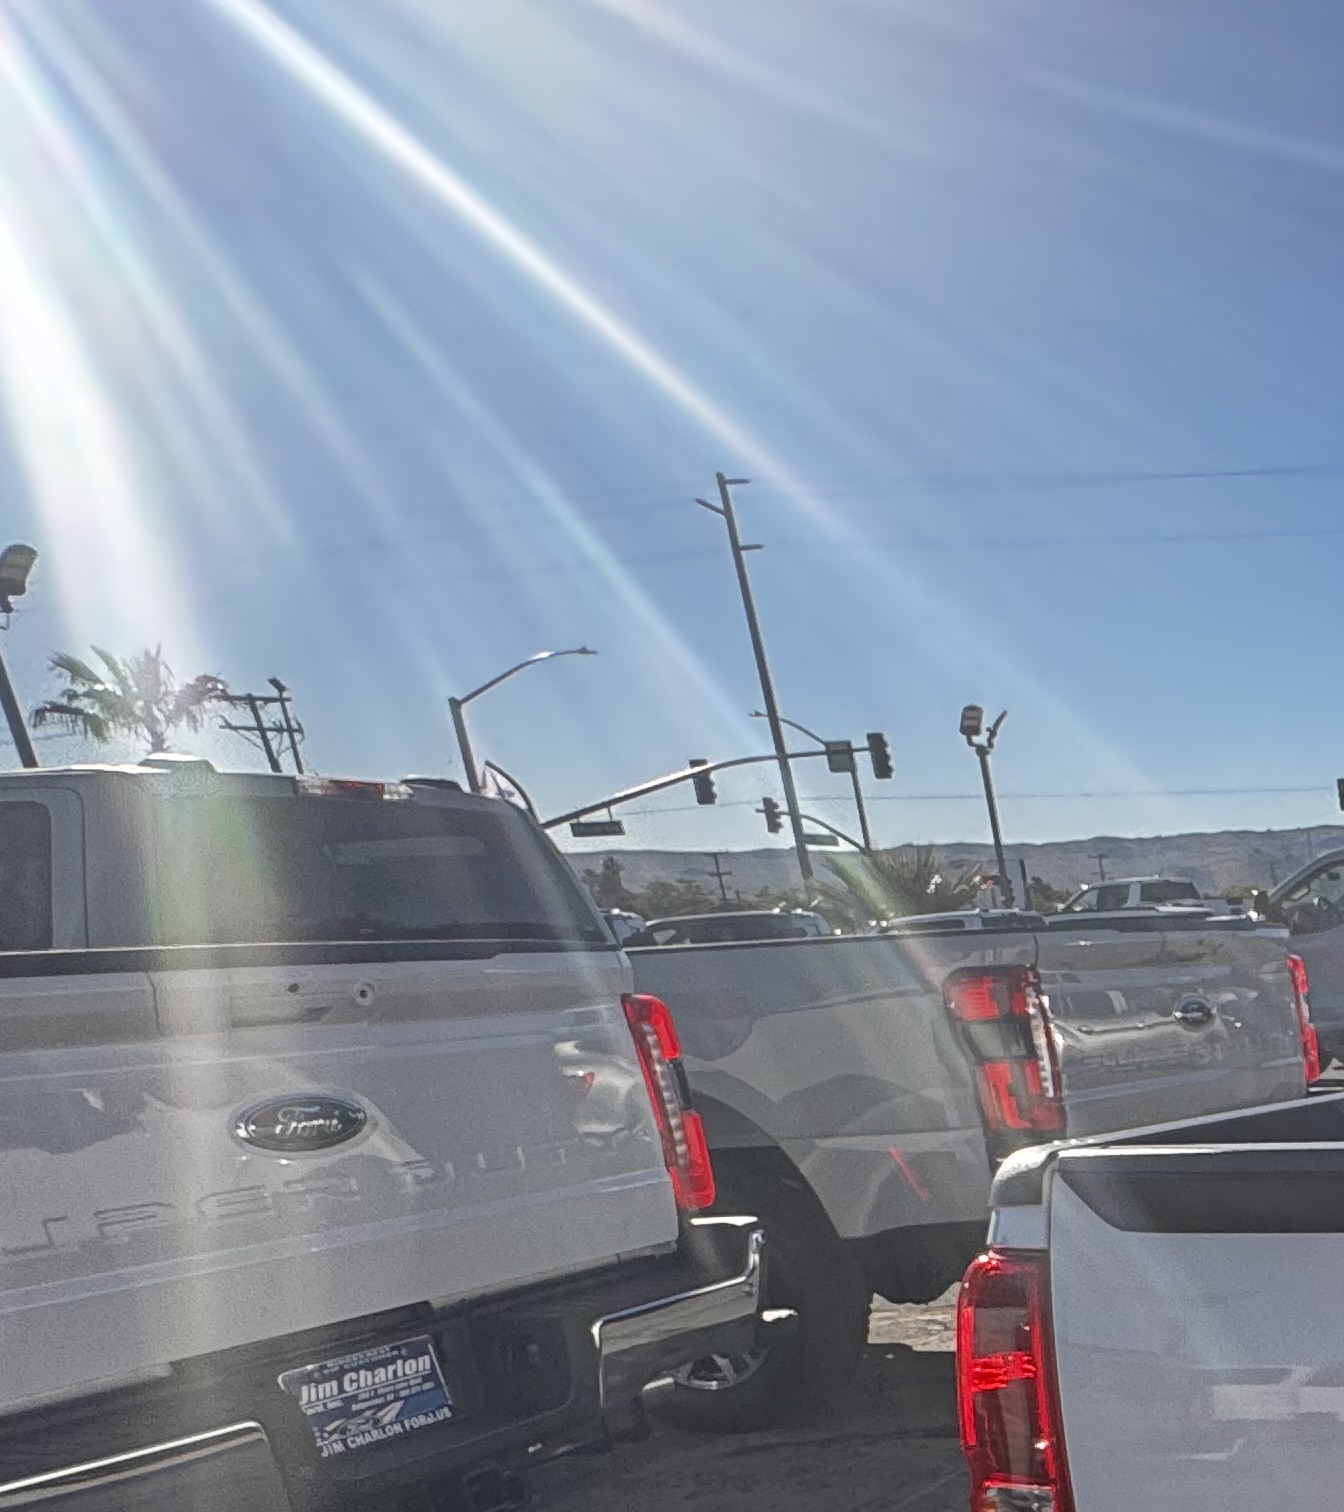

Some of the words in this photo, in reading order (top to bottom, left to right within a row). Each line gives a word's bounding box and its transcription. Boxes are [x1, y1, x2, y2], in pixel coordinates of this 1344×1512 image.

[300, 1379, 339, 1404] Jim
[343, 1354, 431, 1392] Charlon
[320, 1441, 346, 1457] JIM
